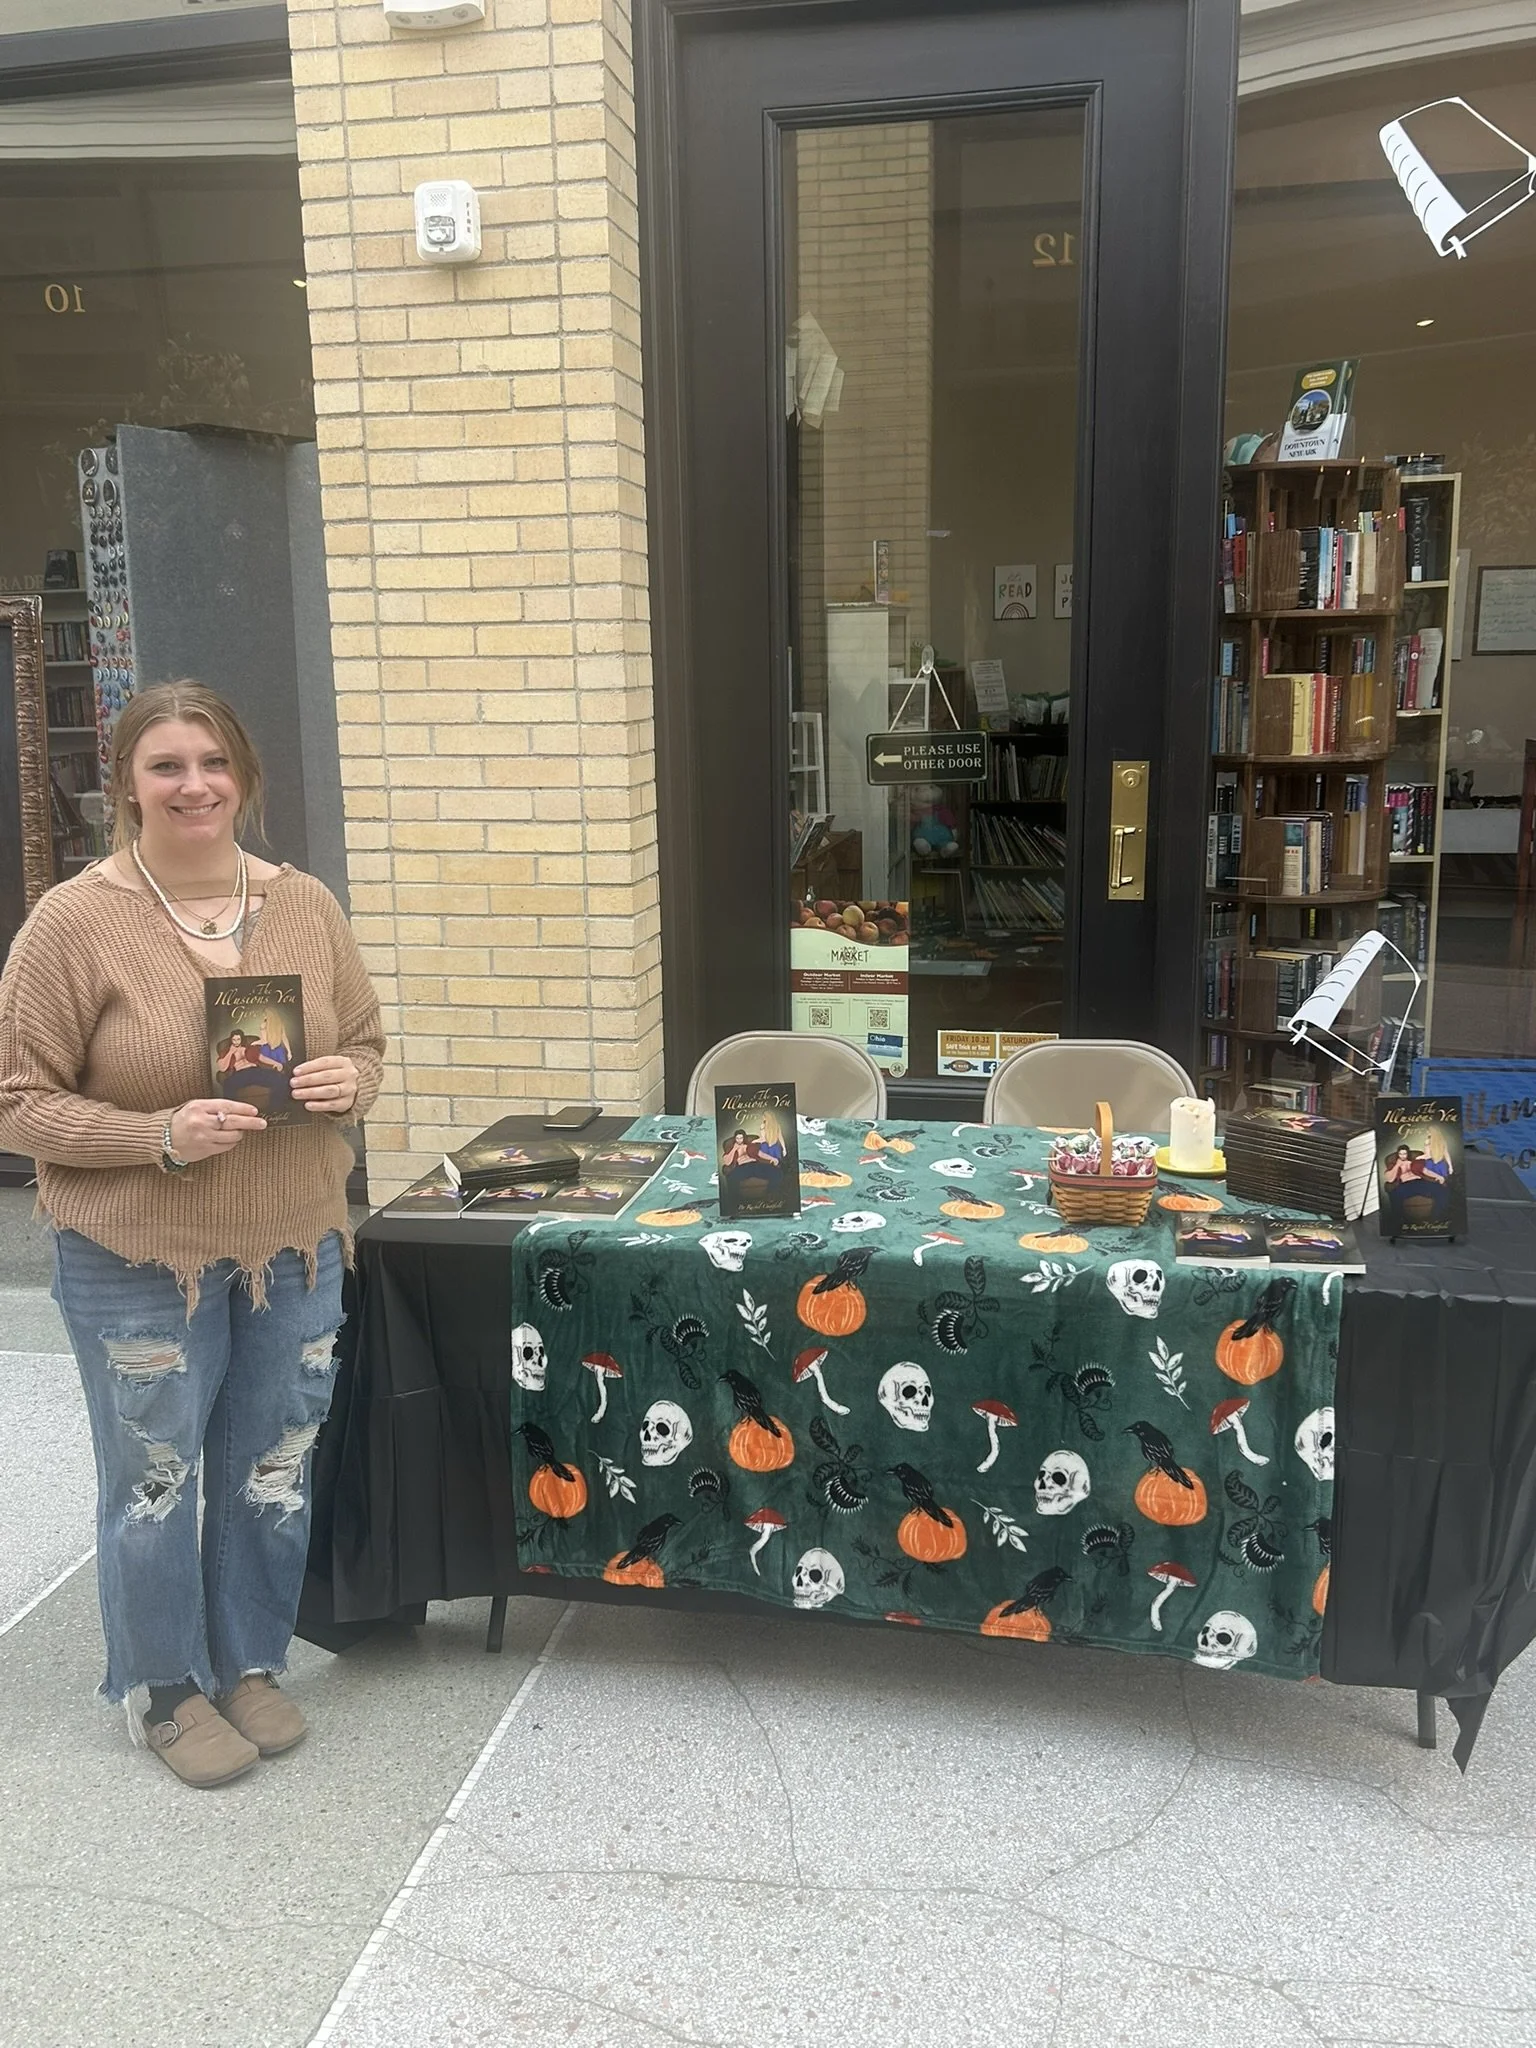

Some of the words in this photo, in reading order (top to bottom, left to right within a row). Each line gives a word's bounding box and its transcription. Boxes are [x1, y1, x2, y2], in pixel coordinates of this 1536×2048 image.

[998, 582, 1033, 599] READ
[903, 744, 954, 756] PLEASE
[956, 743, 981, 754] USE
[903, 758, 945, 770] OTHER
[948, 757, 982, 769] DOOR
[831, 949, 870, 963] MARKET
[213, 988, 269, 1006] Illusions
[275, 988, 297, 1004] You
[946, 1035, 969, 1043] FRIDAY
[721, 1094, 768, 1110] Illusions
[773, 1094, 791, 1108] You
[1382, 1107, 1433, 1124] Illusions
[1438, 1108, 1458, 1122] You
